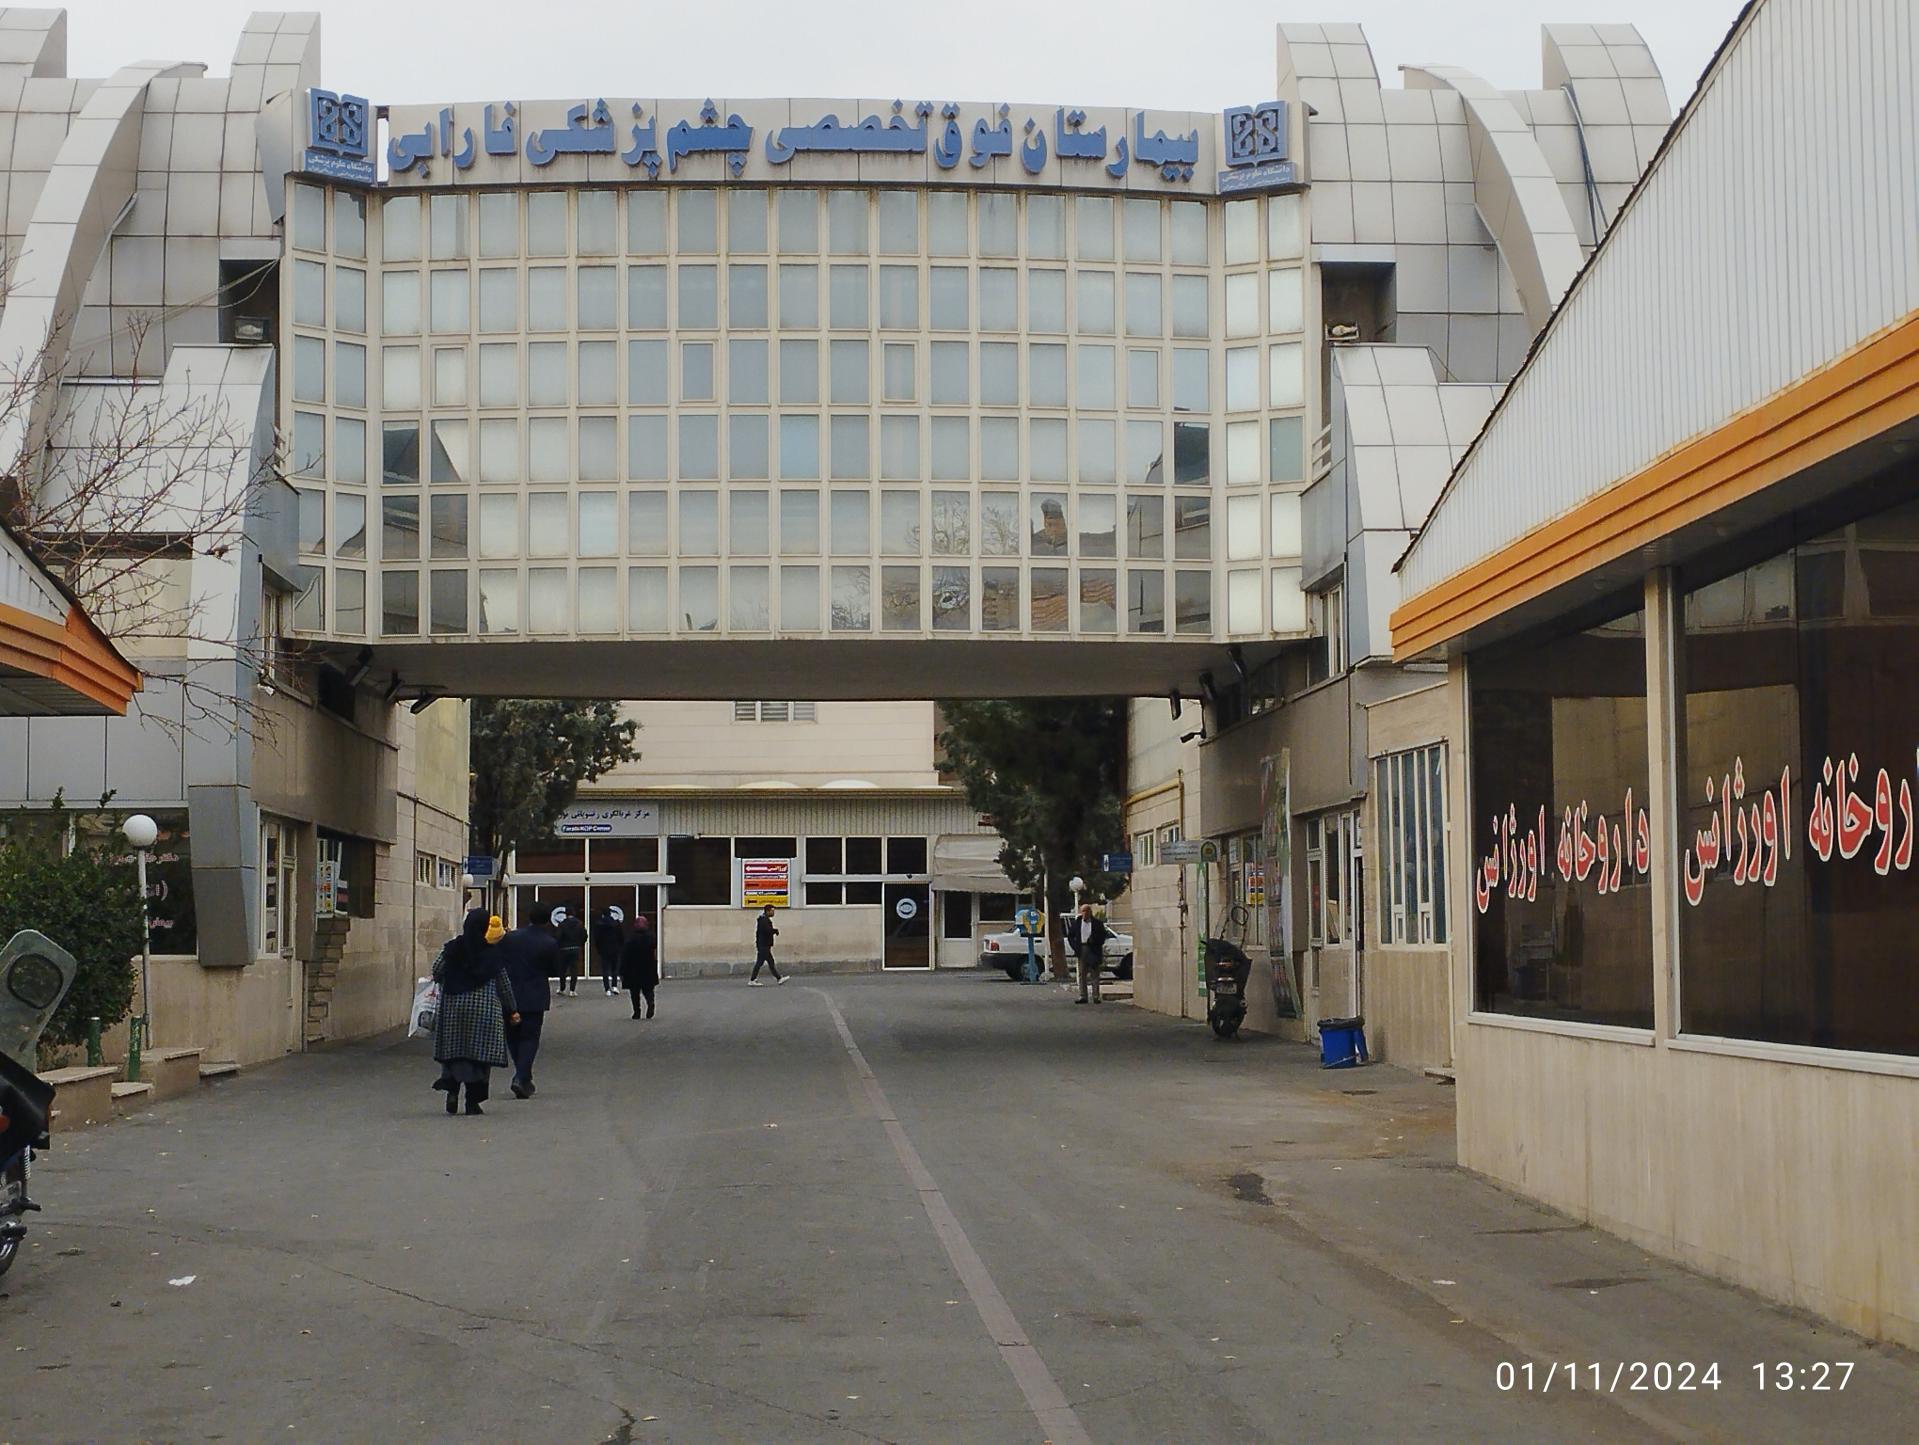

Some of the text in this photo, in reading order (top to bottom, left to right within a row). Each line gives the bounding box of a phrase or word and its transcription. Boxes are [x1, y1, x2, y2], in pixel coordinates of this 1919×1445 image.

[386, 97, 1199, 181] بیمارستان فوق تخصصی چشم پزشکی فارابی
[1476, 786, 1651, 914] داروخانه اورژانس
[1683, 755, 1791, 907] اورژانس
